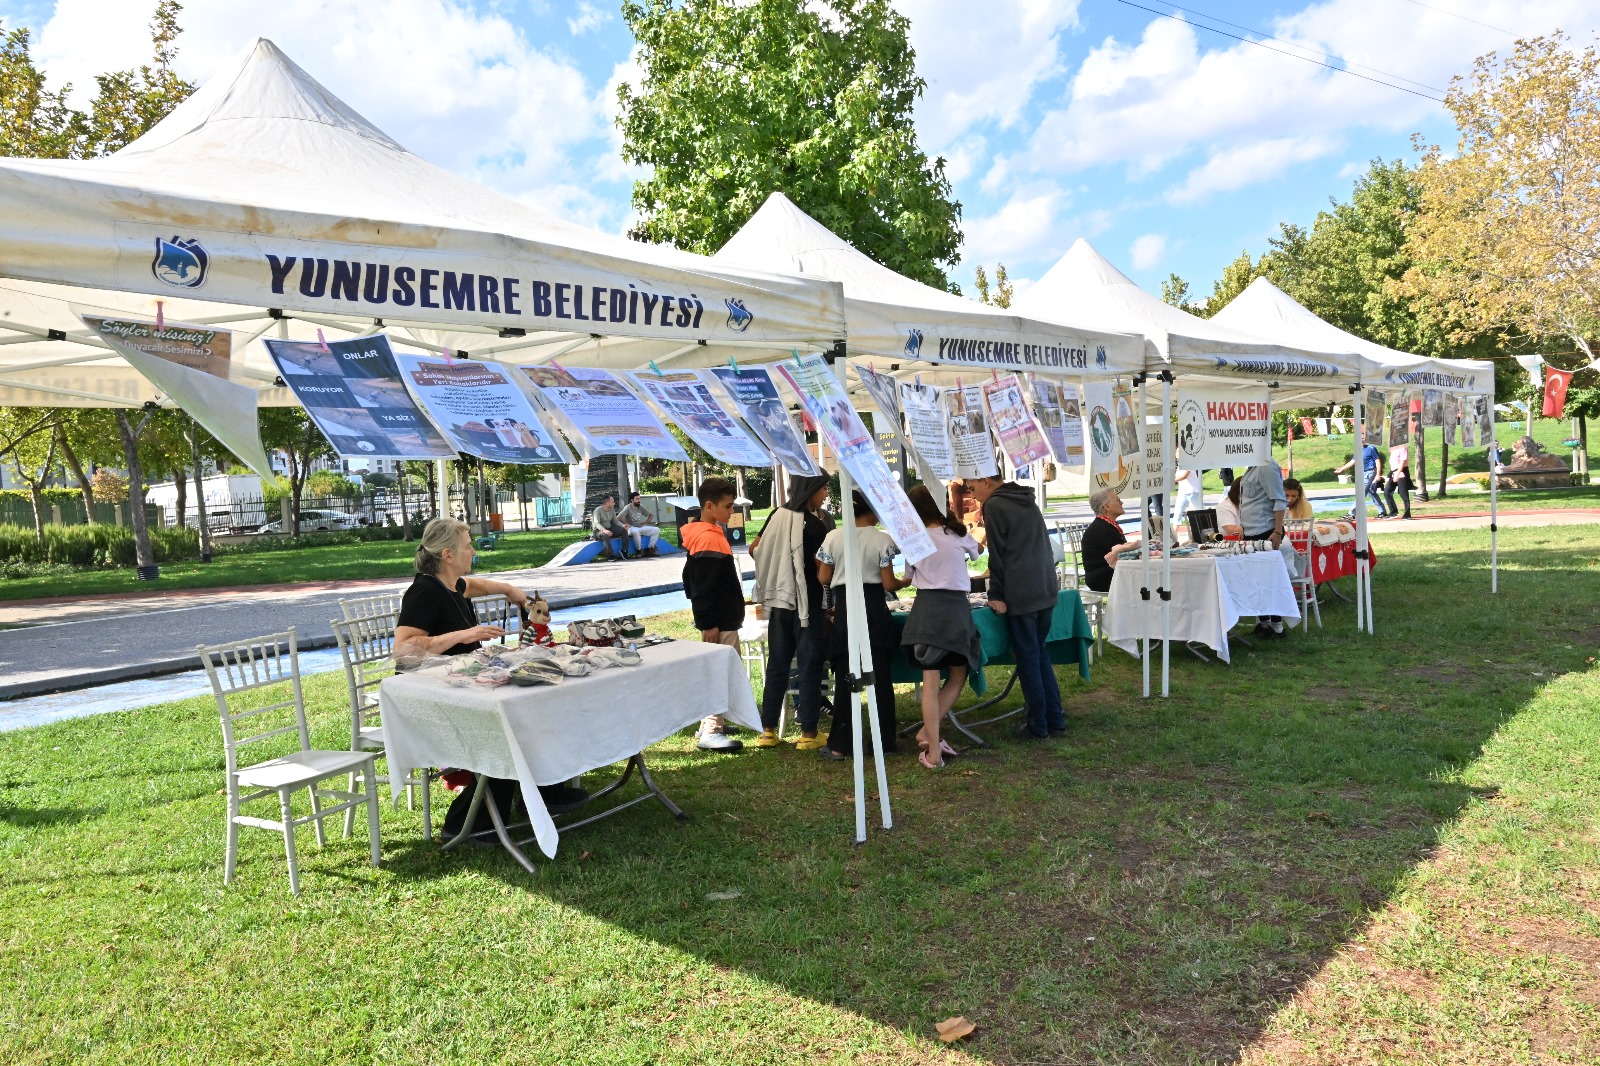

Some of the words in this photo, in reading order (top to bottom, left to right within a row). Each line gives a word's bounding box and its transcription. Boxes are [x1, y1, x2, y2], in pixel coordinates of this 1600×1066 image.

[265, 254, 522, 315] YUNUSEMRE
[532, 280, 704, 329] BELEDİYESİ
[100, 319, 149, 338] Söyler
[342, 349, 379, 361] ONLAR
[938, 337, 1022, 365] YUNUSEMRE
[1023, 342, 1088, 369] BELEDİYESİ
[298, 385, 345, 394] KORUYOR
[1206, 401, 1269, 421] HAKDEM
[1225, 441, 1254, 455] MANİSA
